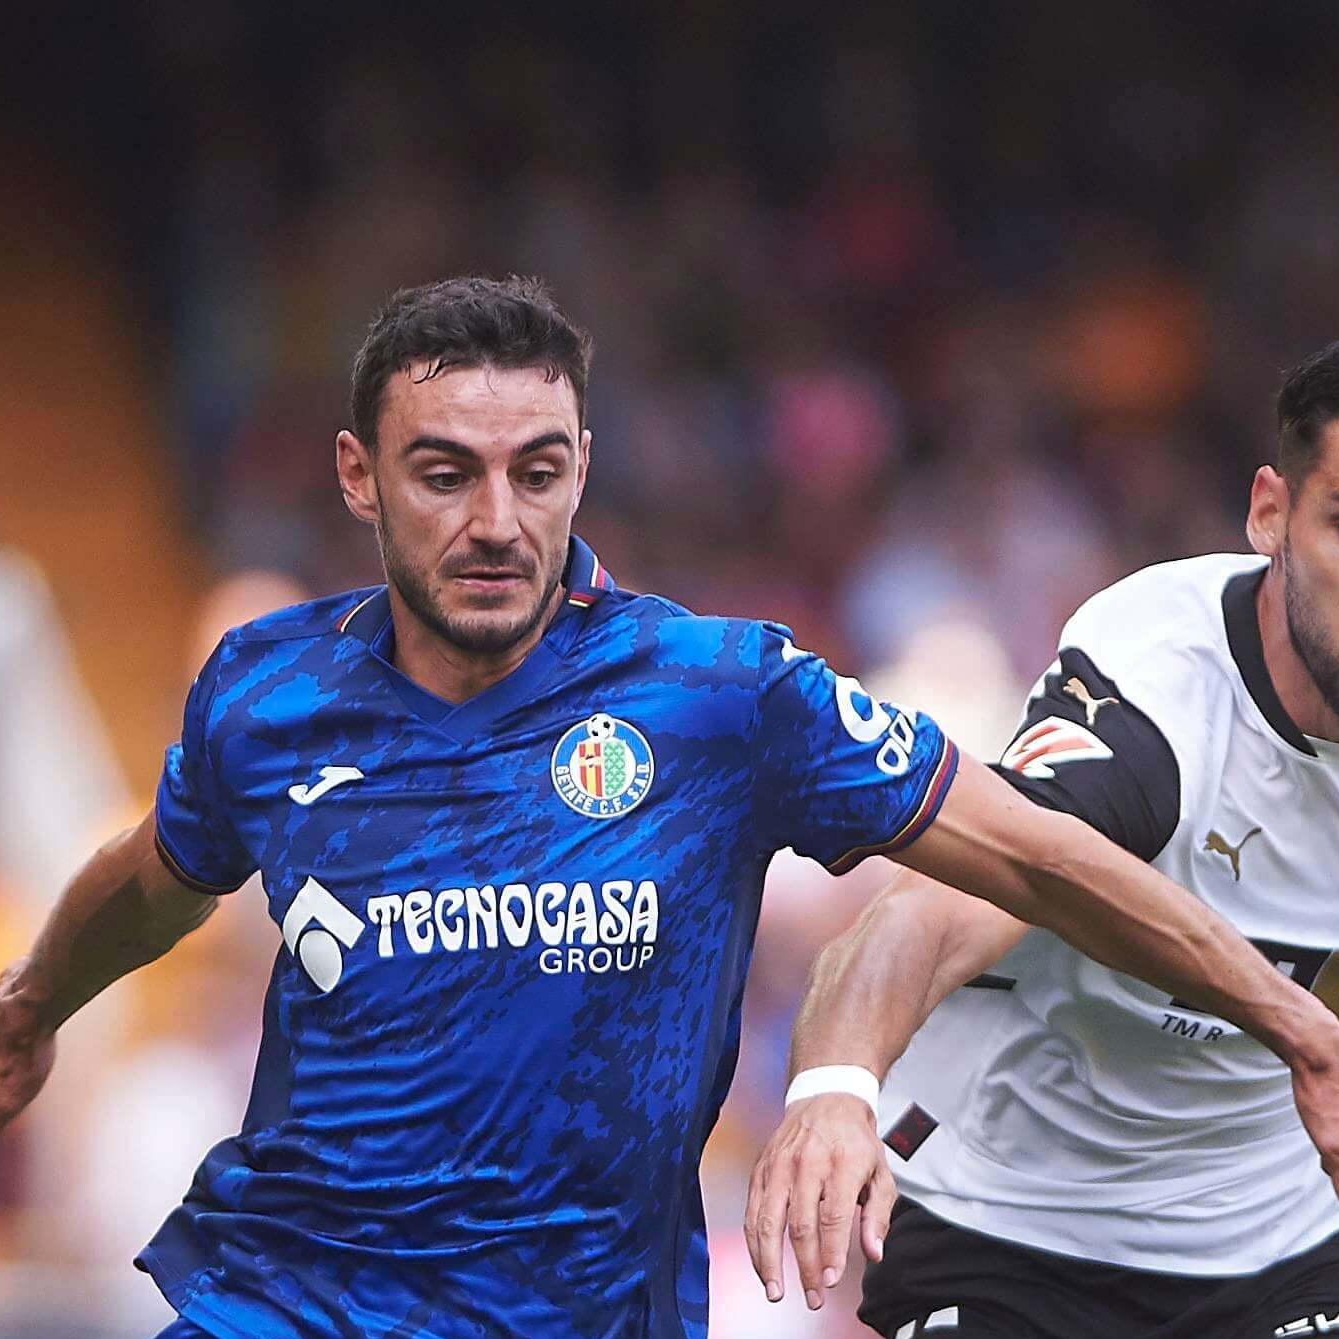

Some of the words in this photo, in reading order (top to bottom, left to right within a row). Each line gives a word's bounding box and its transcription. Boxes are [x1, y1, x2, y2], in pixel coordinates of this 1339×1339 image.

[556, 765, 594, 811] GETAFE
[366, 880, 659, 957] TECNOCASA
[539, 945, 654, 974] GROUP
[1161, 1013, 1197, 1039] TM
